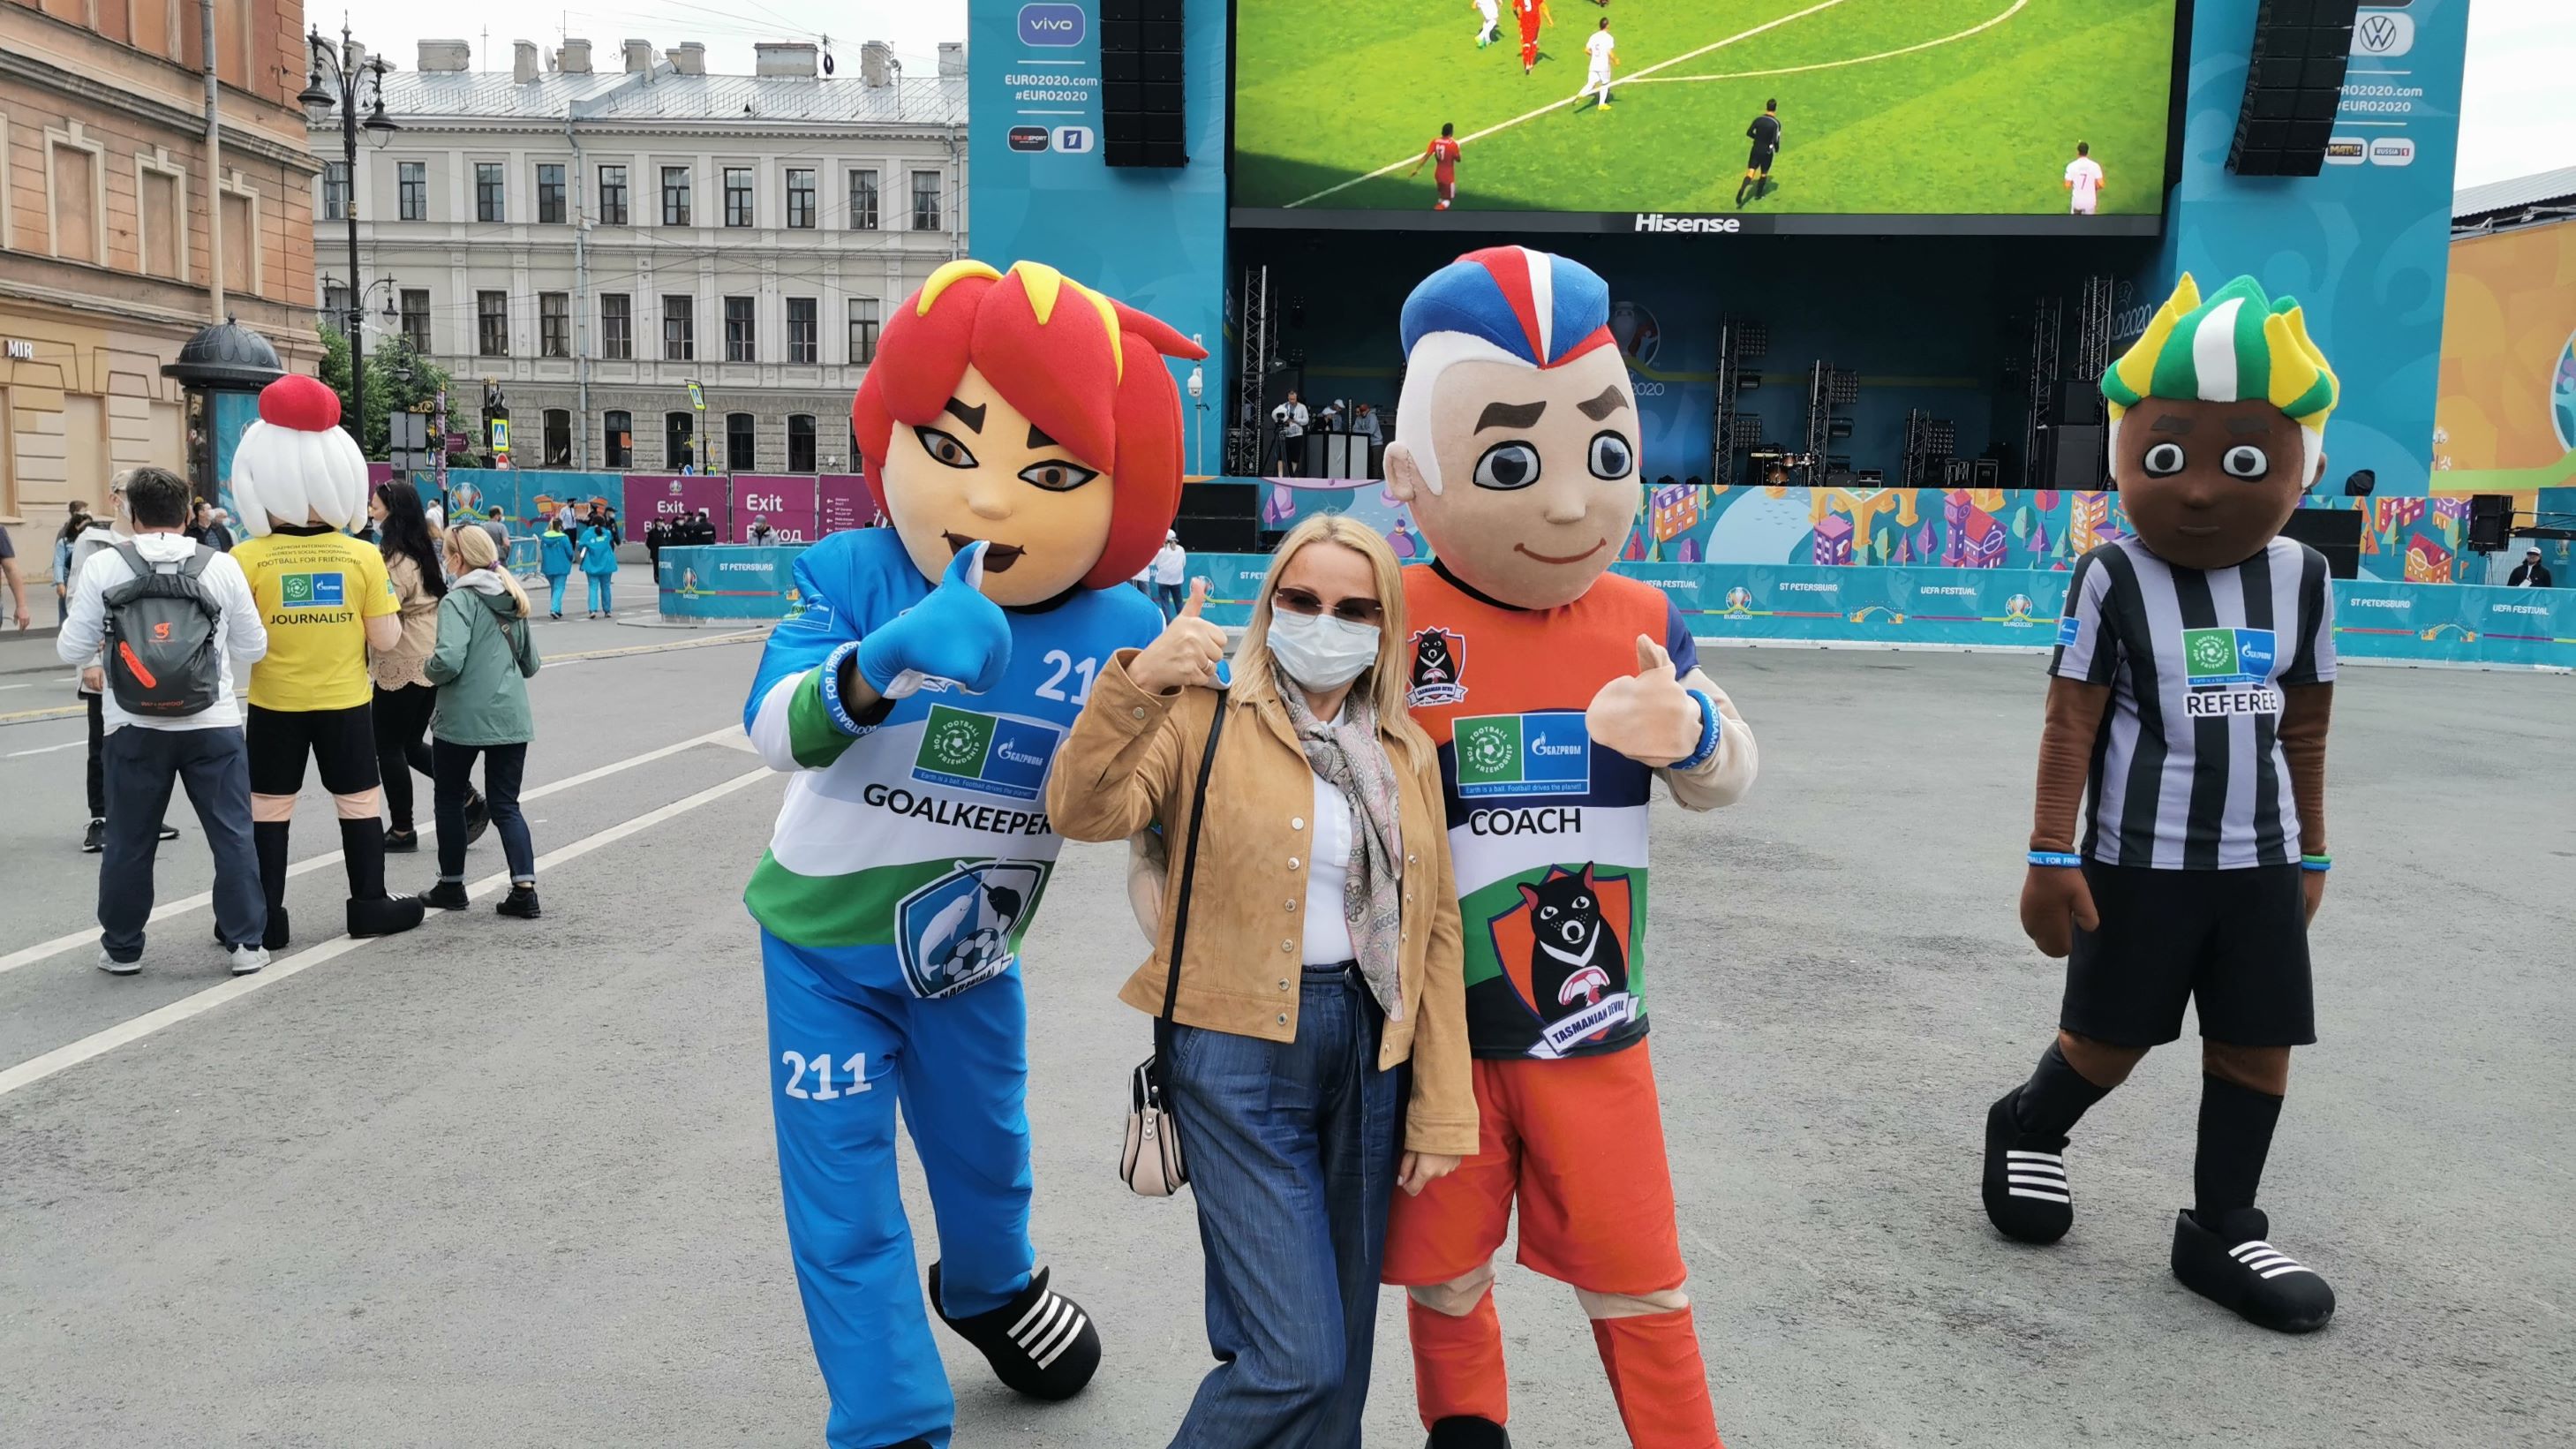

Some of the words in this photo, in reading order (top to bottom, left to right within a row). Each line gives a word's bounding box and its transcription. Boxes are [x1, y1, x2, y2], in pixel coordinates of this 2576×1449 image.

[1030, 17, 1073, 31] vivo
[1005, 74, 1097, 87] EURO2020.com
[1015, 90, 1088, 102] #EURO2020
[2341, 85, 2423, 96] RO2020.com
[2080, 173, 2088, 191] 7
[1635, 214, 1740, 233] Hisense
[7, 340, 34, 359] MIR
[657, 500, 685, 514] Exit
[745, 494, 783, 512] Exit
[258, 557, 298, 568] FOOTBALL
[1663, 580, 1699, 589] FESTIVAL
[1790, 583, 1838, 592] PETERSBURG
[1940, 586, 1977, 595] FESTIVAL
[2361, 599, 2411, 608] PETERSBURG
[2492, 604, 2512, 613] UEFA
[2512, 605, 2550, 615] FESTIVAL
[270, 612, 354, 625] JOURNALIST
[1035, 649, 1097, 706] 21
[825, 676, 837, 700] FOR
[2186, 692, 2278, 714] REFEREE
[943, 720, 980, 737] FOOTBALL
[1470, 726, 1508, 741] FOOTBALL
[933, 734, 942, 750] FOR
[938, 742, 980, 766] FRIENDSHIP
[1547, 745, 1581, 755] GAZPROM
[1010, 755, 1043, 766] GAZPROM
[1475, 743, 1512, 774] FRIENDSHIP
[863, 783, 1052, 835] GOALKEEPER
[1470, 808, 1581, 836] COACH
[2045, 857, 2061, 865] FOR
[1552, 1008, 1608, 1045] TASMANIAN
[1607, 1000, 1624, 1015] DEVIL
[781, 1050, 872, 1101] 211
